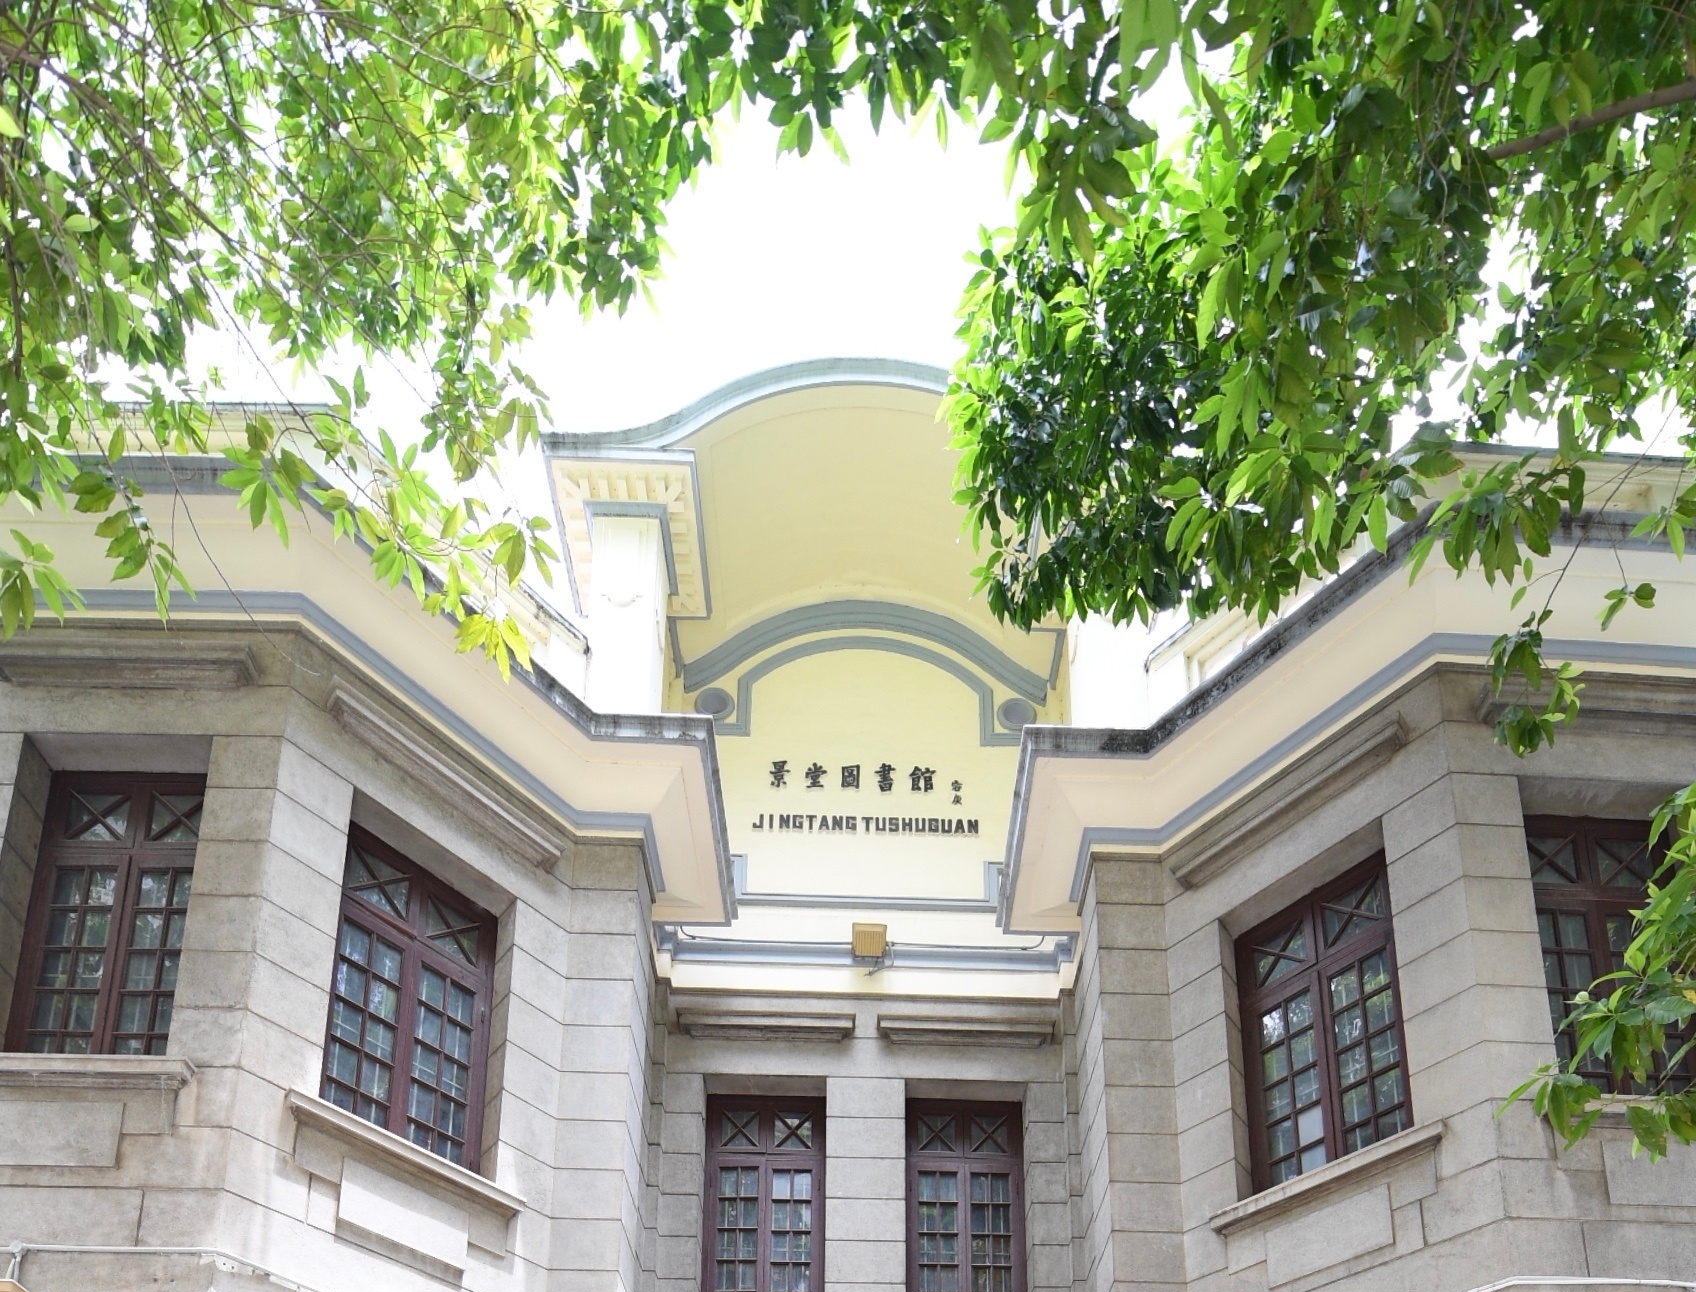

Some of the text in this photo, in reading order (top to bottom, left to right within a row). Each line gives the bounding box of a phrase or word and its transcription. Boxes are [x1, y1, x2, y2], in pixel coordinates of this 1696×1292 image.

[769, 760, 937, 792] 景堂圖書館
[752, 814, 979, 834] JINGTANG TUSHUGUAN
